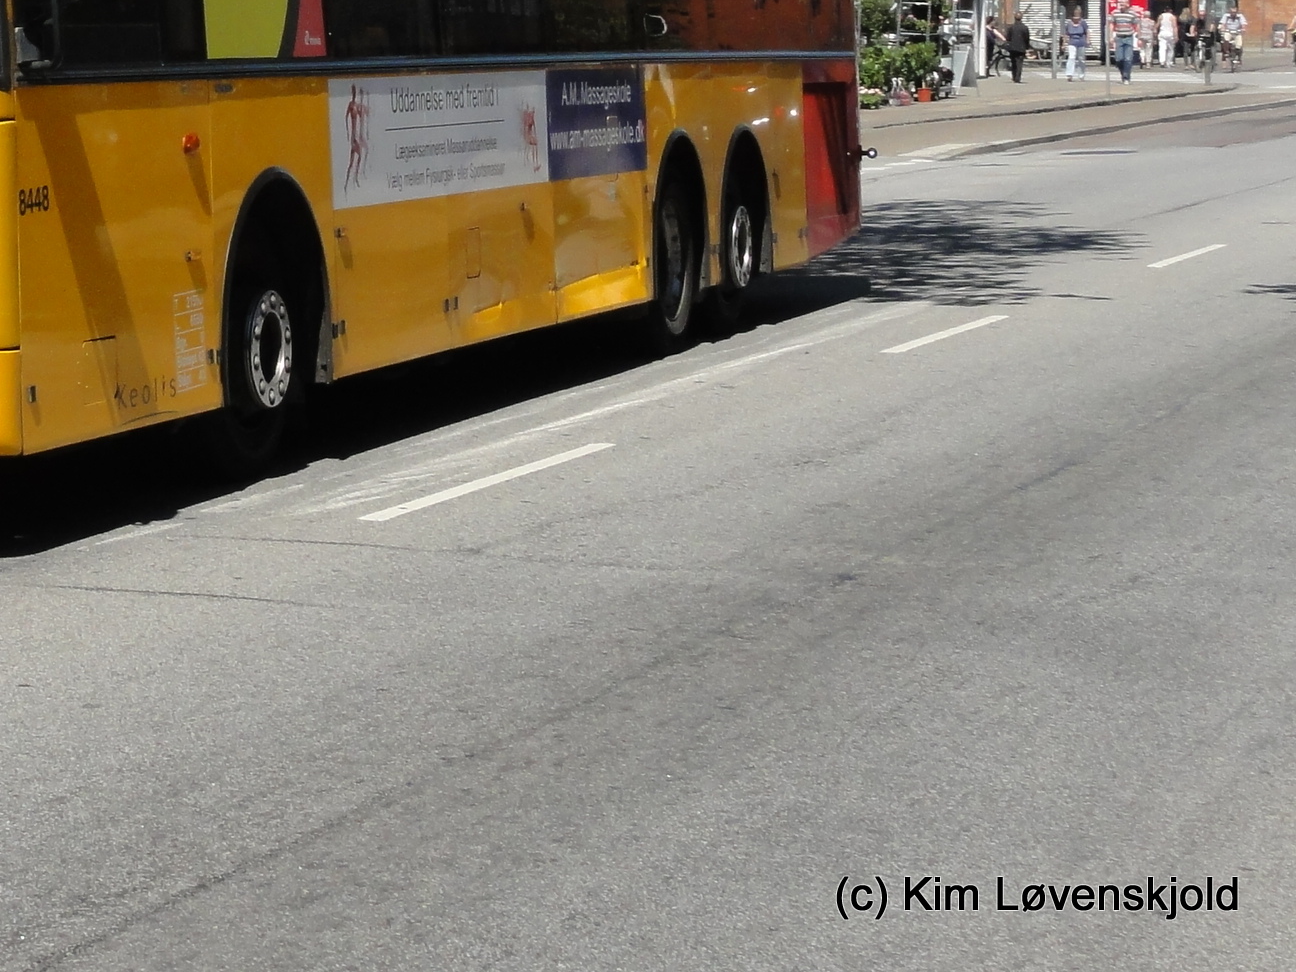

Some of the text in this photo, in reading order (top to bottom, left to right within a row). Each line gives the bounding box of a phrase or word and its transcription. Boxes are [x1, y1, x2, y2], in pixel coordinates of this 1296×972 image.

[390, 86, 444, 114] Uddannelse
[445, 86, 464, 110] med
[466, 83, 495, 108] fremtid
[18, 186, 50, 216] 8448
[115, 376, 177, 410] Keolis
